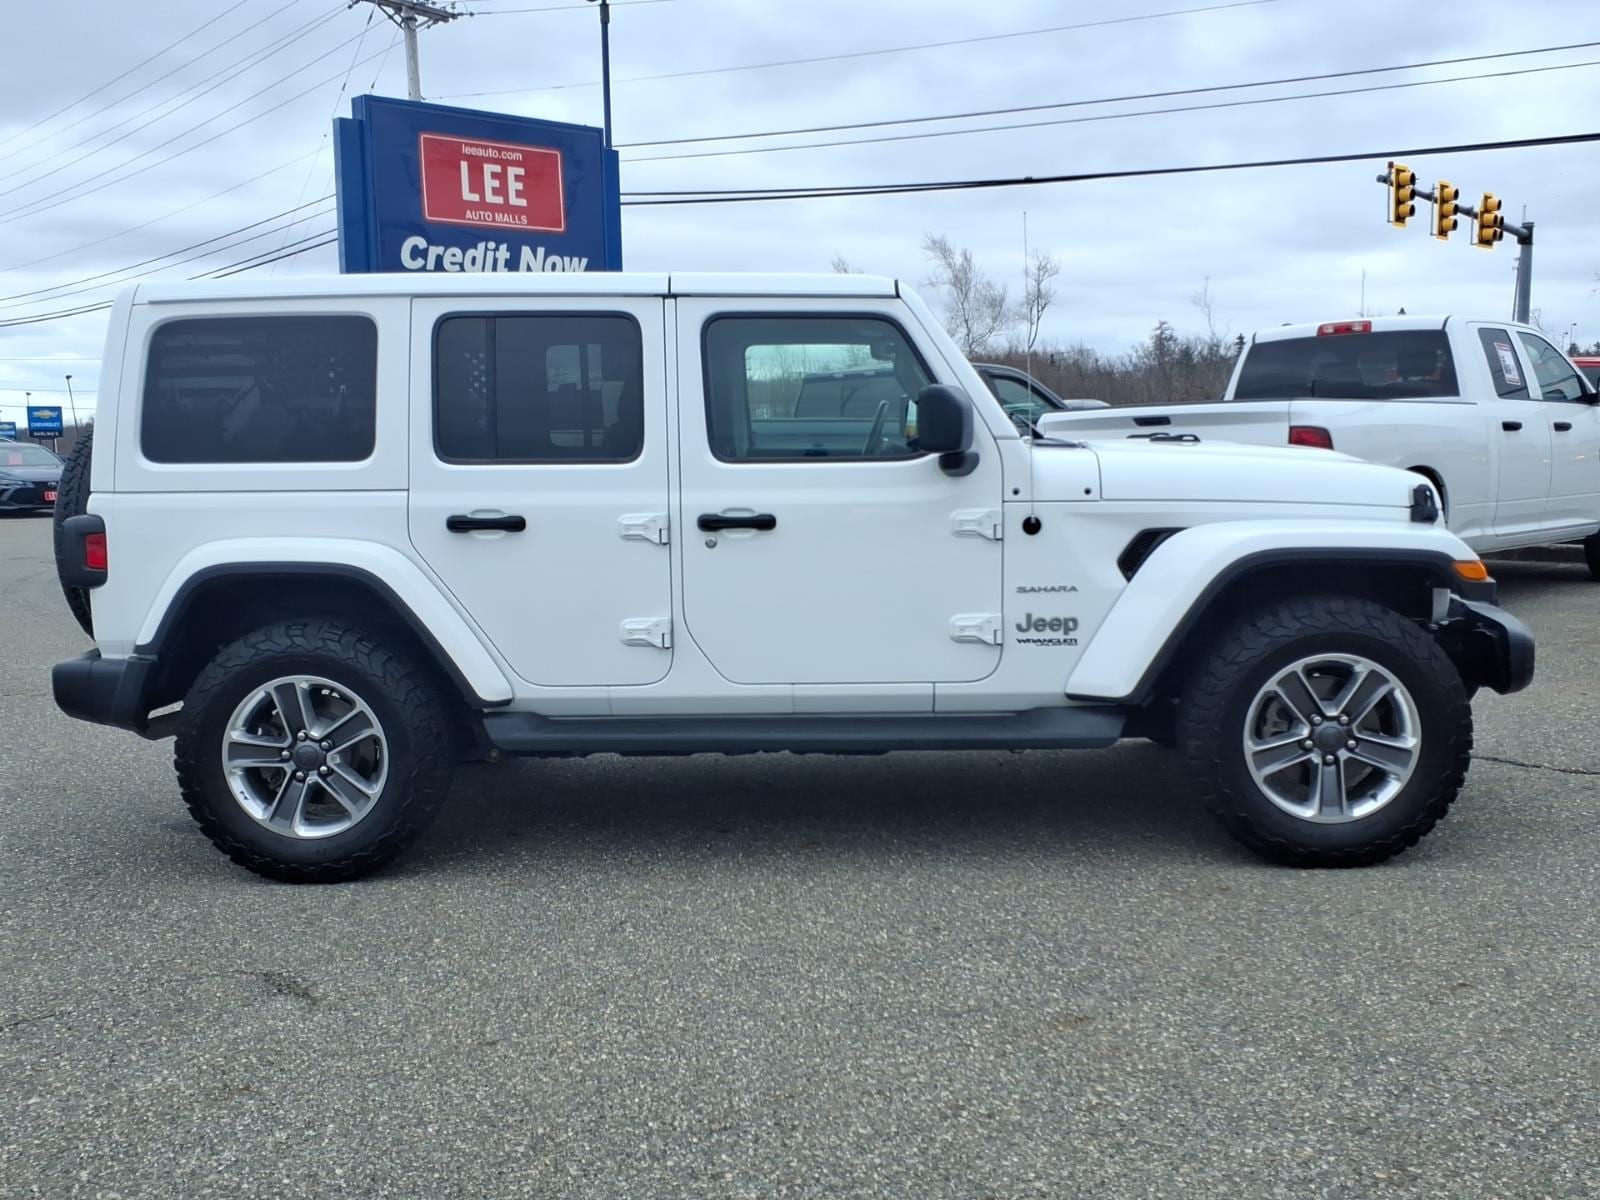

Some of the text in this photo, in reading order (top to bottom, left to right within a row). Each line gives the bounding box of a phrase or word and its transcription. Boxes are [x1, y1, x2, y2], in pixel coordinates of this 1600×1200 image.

[462, 143, 523, 161] leeauto.com
[460, 160, 528, 207] LEE
[465, 209, 528, 225] AUTO MALLS
[400, 235, 589, 273] Credit Now
[1016, 585, 1079, 594] SAHARA
[1015, 612, 1079, 636] Jeep
